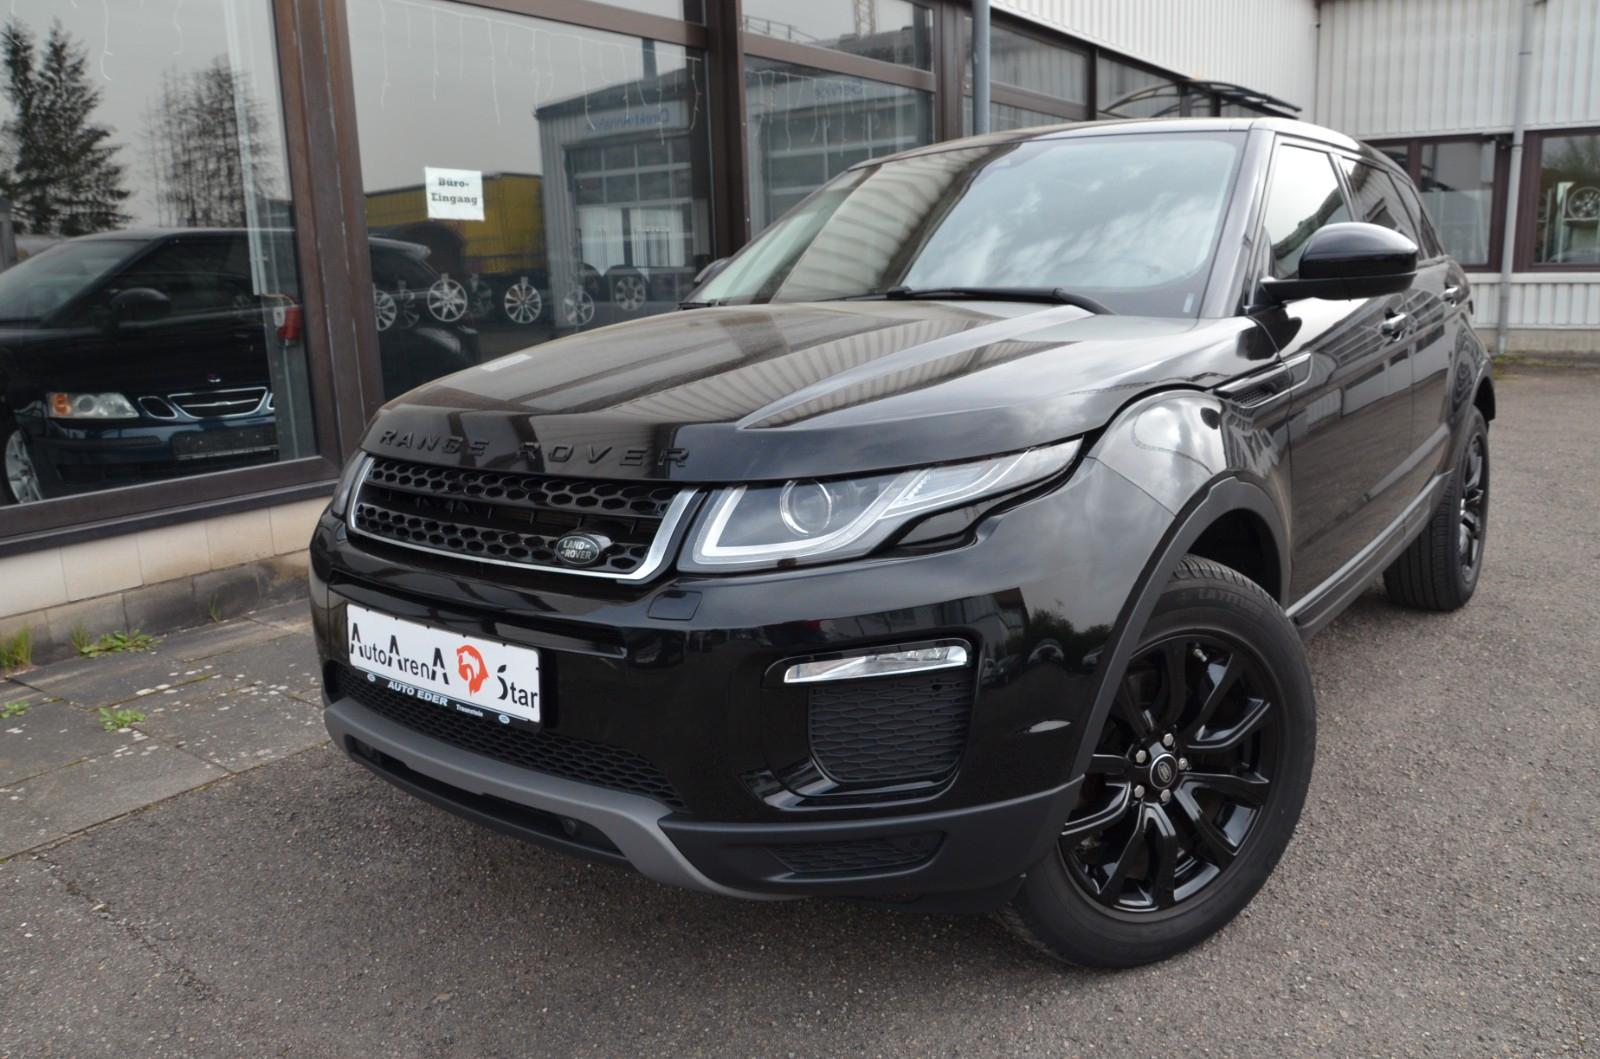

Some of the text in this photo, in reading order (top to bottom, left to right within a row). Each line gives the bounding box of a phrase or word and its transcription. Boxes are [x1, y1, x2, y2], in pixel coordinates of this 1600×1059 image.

[438, 177, 470, 188] Büro-
[431, 192, 478, 206] Eingang
[378, 430, 689, 467] RANGE ROVER
[563, 540, 585, 550] LAND
[564, 549, 592, 560] ROVER
[387, 680, 415, 696] AUTO
[417, 690, 449, 707] EDER
